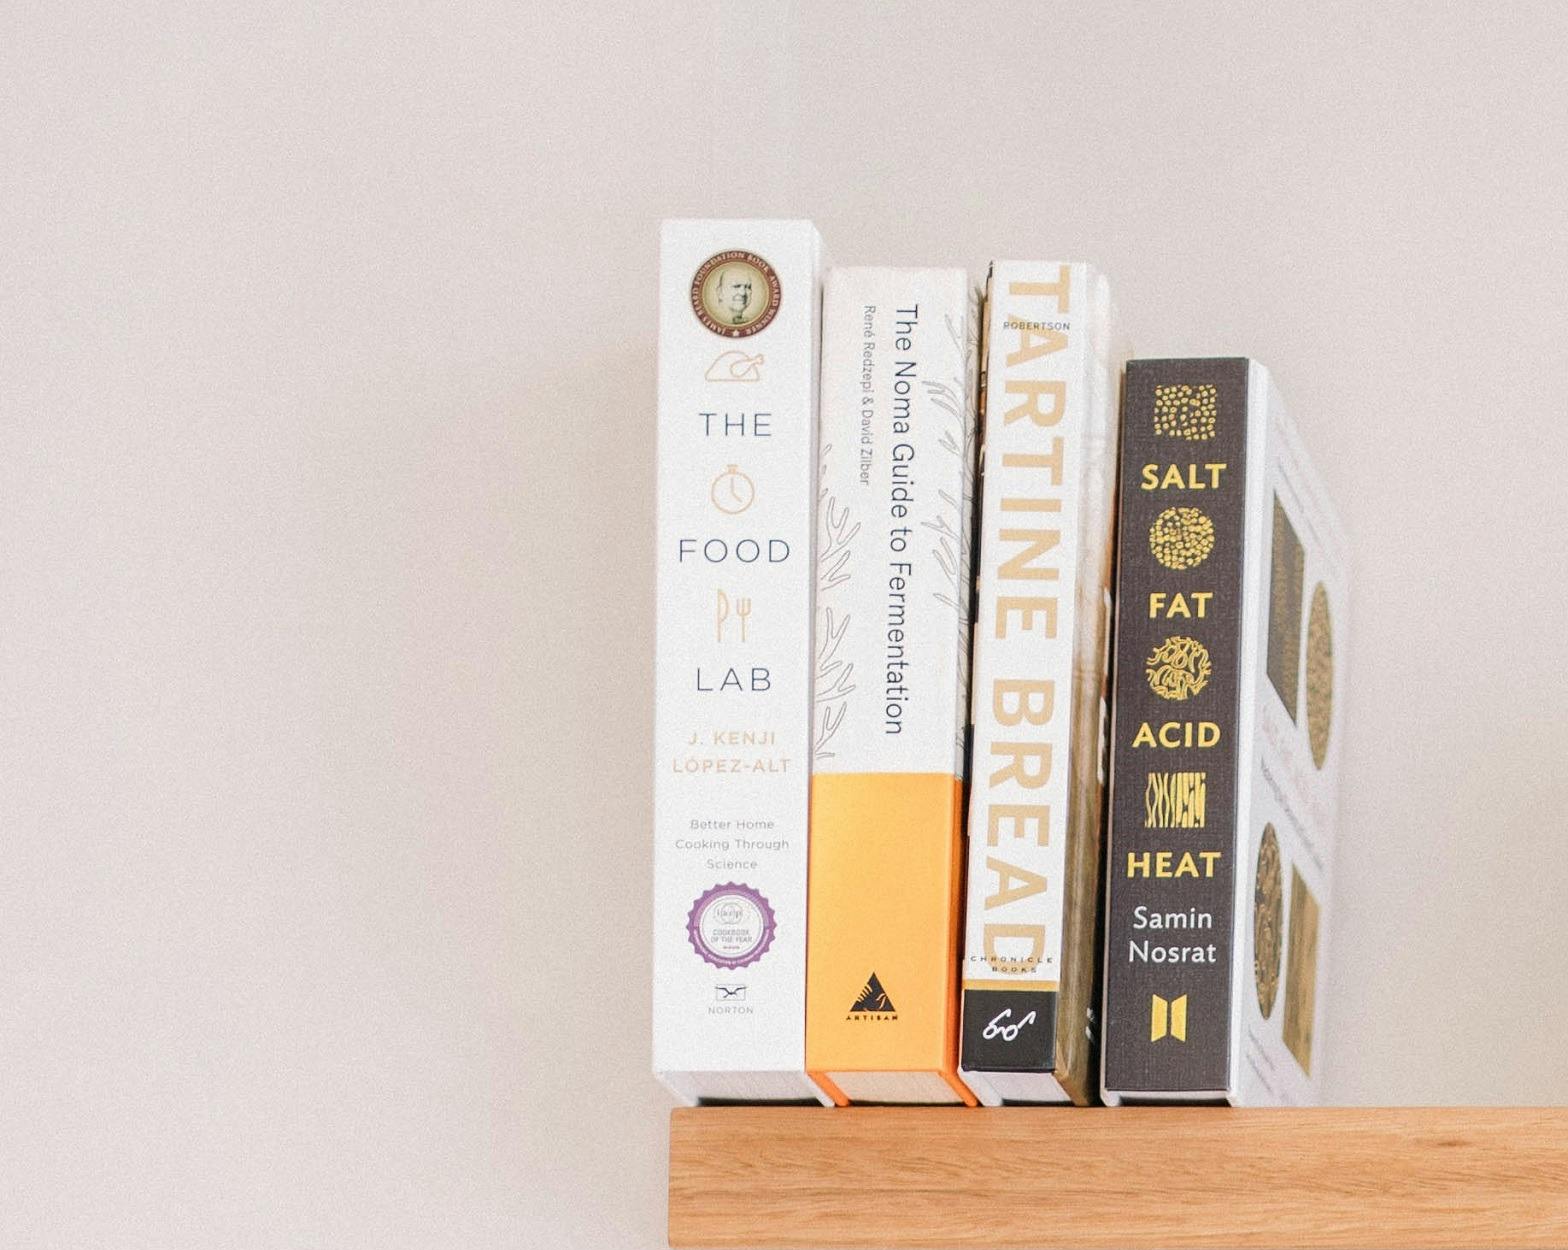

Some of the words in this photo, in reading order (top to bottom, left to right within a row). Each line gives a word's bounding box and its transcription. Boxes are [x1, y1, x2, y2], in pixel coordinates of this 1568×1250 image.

[863, 304, 877, 339] René
[895, 304, 919, 351] The
[1003, 321, 1071, 331] ROBERTSON
[859, 341, 876, 393] Redzepi
[862, 396, 874, 405] &
[892, 361, 917, 434] Noma
[699, 412, 773, 437] THE
[860, 409, 874, 445] David
[995, 264, 1071, 640] TARTINE
[859, 448, 873, 486] Zilber
[1140, 463, 1228, 490] SALT
[890, 443, 915, 519] Guide
[679, 538, 791, 563] FOOD
[890, 527, 912, 552] to
[1149, 592, 1214, 619] FAT
[884, 562, 911, 736] Fermentation
[696, 667, 772, 692] LAB
[688, 732, 704, 745] J.
[713, 731, 776, 745] KENJI
[1132, 722, 1222, 749] ACID
[690, 819, 732, 830] Better
[736, 819, 775, 830] Home
[982, 678, 1056, 975] BREAD
[675, 839, 730, 851] Cooking
[735, 839, 789, 851] Through
[706, 858, 758, 870] Science
[1126, 852, 1222, 878] HEAT
[1133, 905, 1213, 930] Samin
[970, 955, 1053, 963] CHRONICLE
[1128, 939, 1217, 963] Nosrat
[992, 966, 1037, 974] BOOKS
[708, 1006, 754, 1015] NORTON
